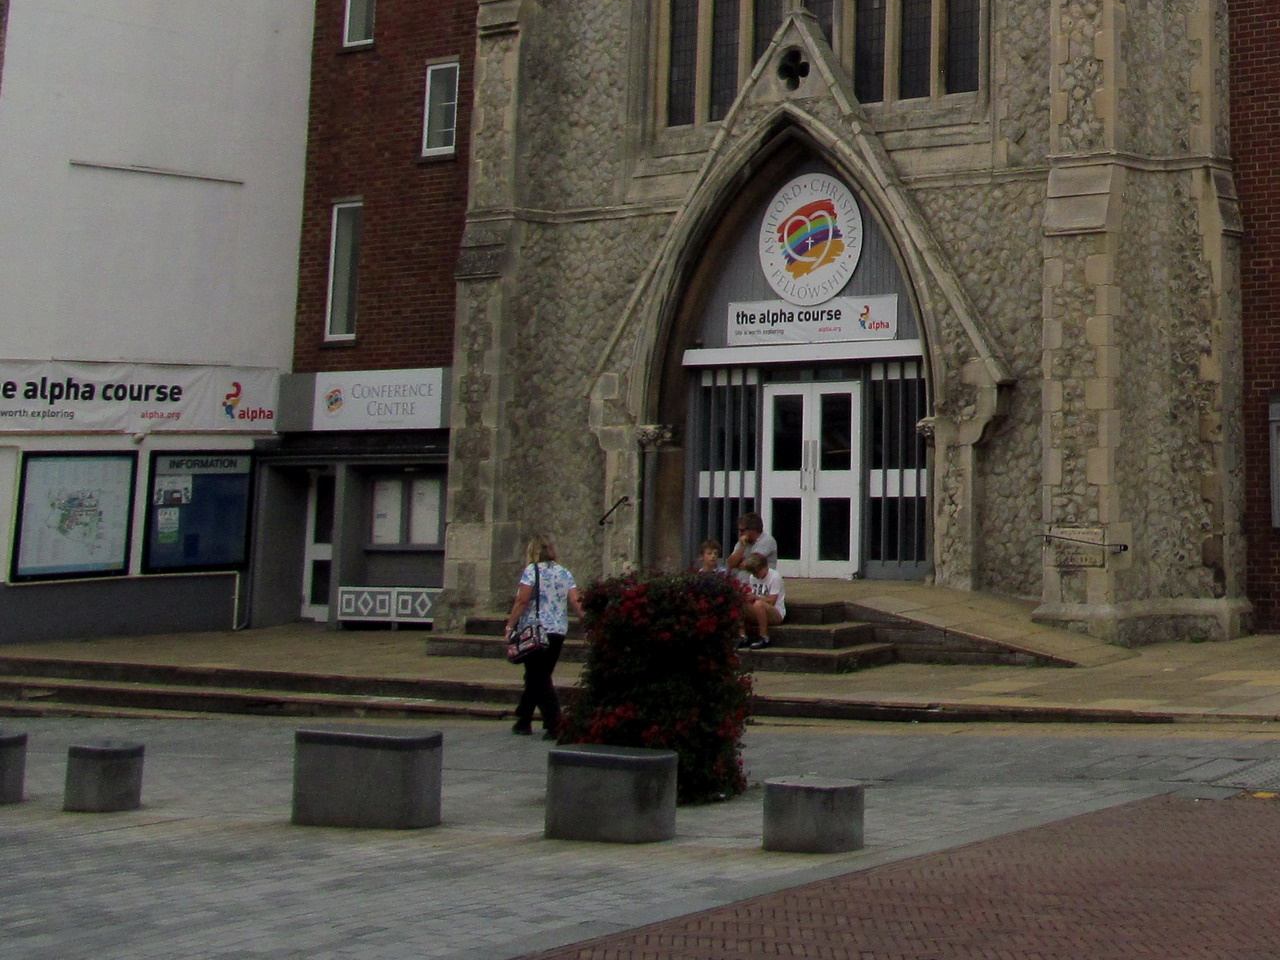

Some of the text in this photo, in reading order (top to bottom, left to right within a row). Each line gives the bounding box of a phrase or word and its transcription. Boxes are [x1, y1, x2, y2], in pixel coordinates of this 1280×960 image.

[765, 179, 857, 254] ASHFORD CHRISTIAN
[771, 261, 849, 299] FELLOWSHIP
[736, 309, 842, 326] the alpha course
[868, 321, 890, 331] alpha
[0, 376, 182, 405] e alpha course
[351, 383, 433, 399] CONFERENCE
[31, 409, 75, 419] exploring
[140, 411, 181, 421] alpha.org
[238, 407, 274, 421] alpha
[366, 400, 416, 416] CENTRE
[169, 459, 237, 469] INFORMATION
